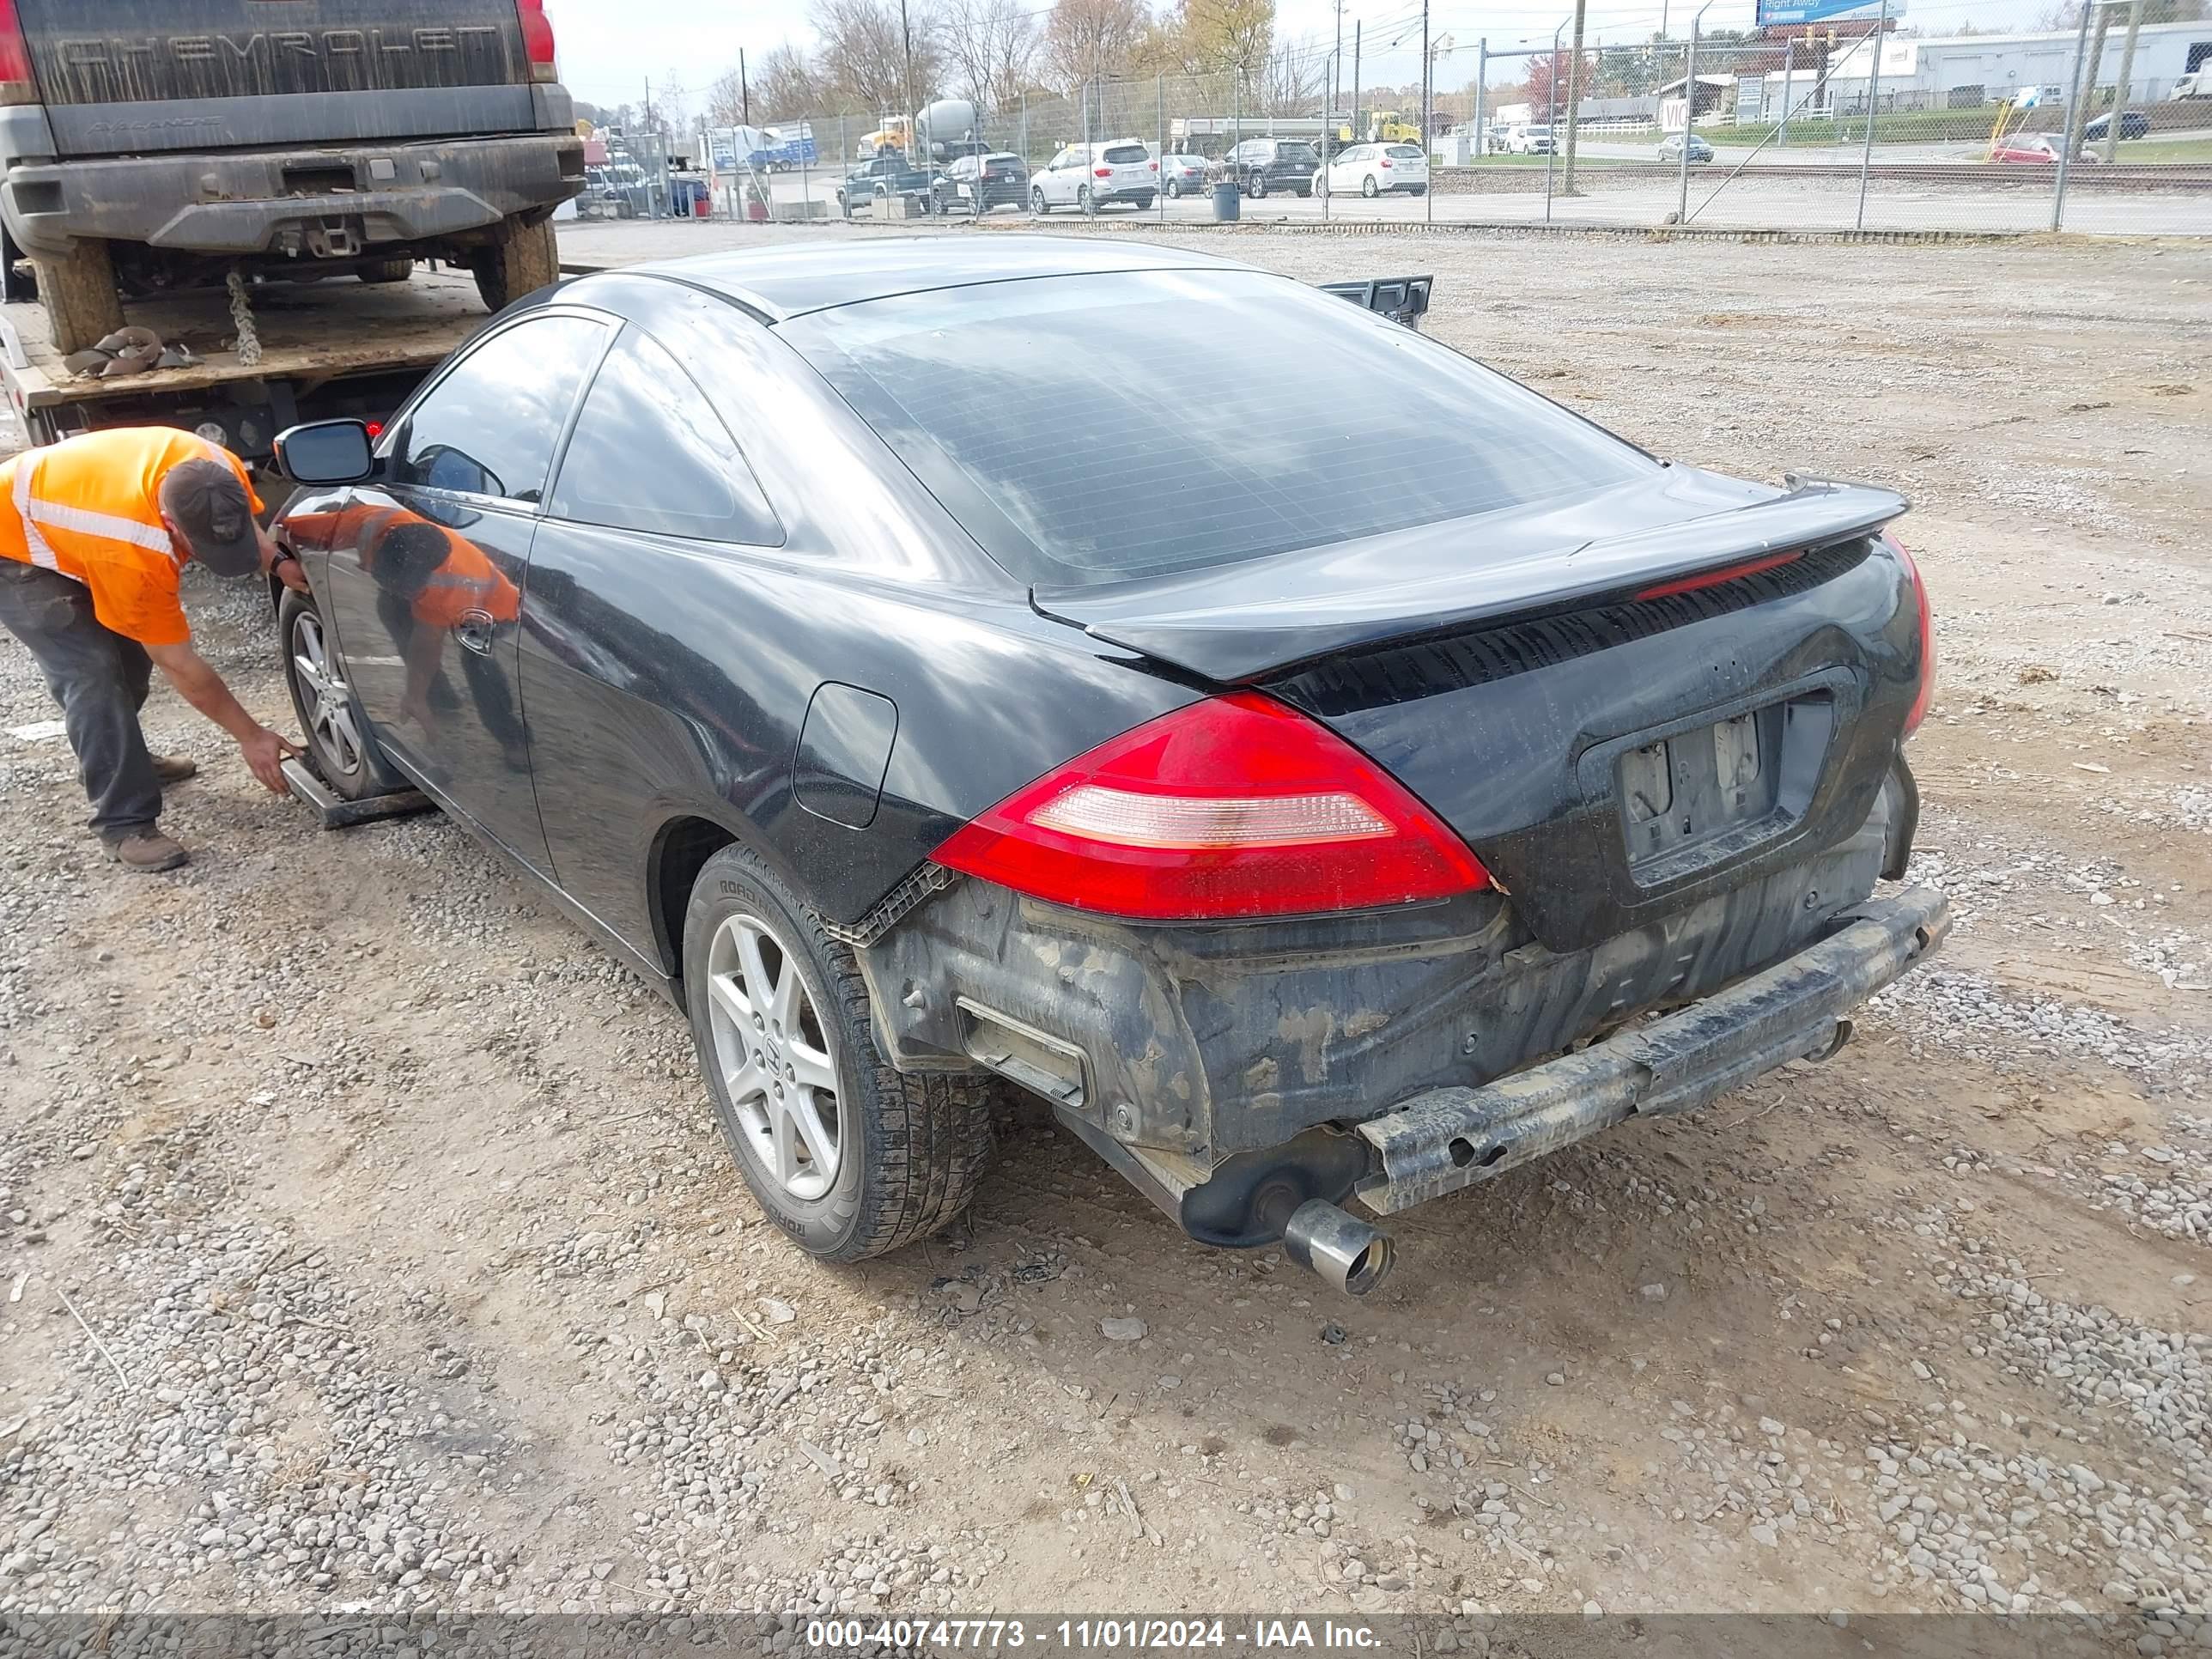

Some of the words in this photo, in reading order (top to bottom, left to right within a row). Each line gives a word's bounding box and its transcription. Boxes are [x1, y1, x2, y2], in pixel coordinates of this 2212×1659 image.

[1765, 0, 1790, 10] Right
[58, 27, 496, 65] CHEVROLET
[720, 880, 756, 903] ROAD
